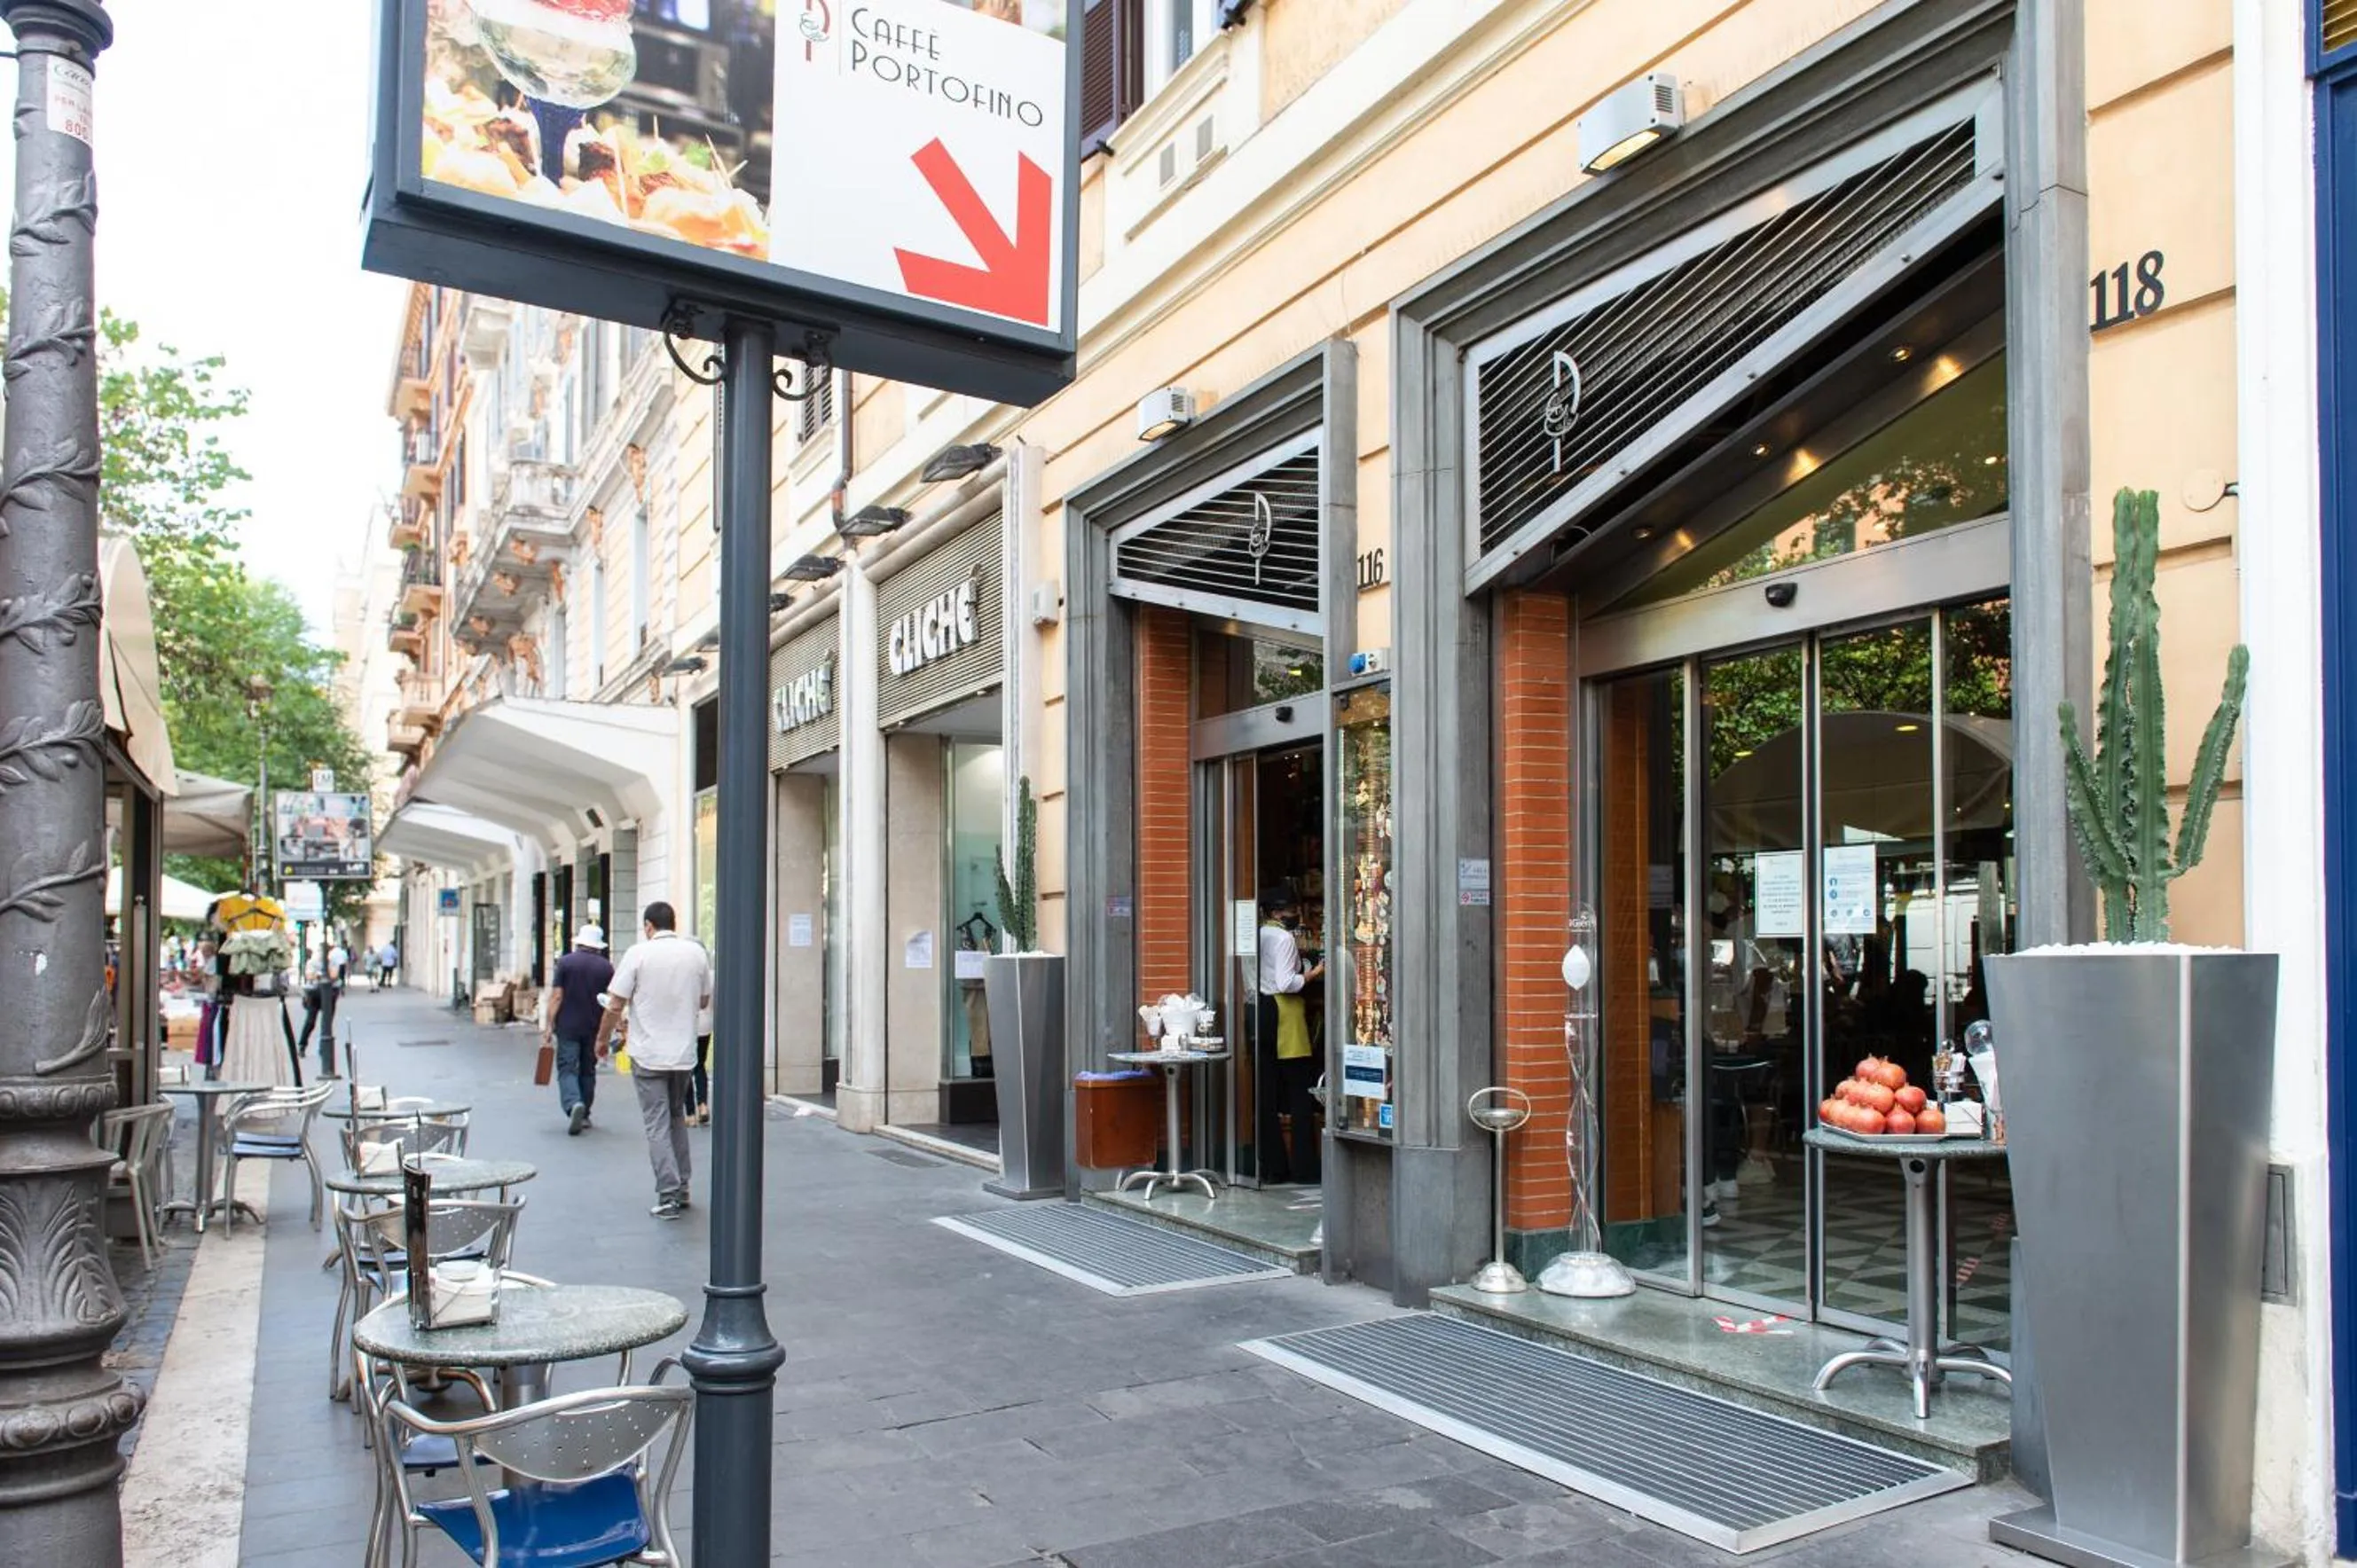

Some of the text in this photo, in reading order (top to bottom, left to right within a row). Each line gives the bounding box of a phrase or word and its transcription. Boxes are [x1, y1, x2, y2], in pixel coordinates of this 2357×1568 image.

[852, 39, 1043, 127] PORTOFINO
[2089, 250, 2165, 333] 118
[1358, 547, 1384, 589] 116
